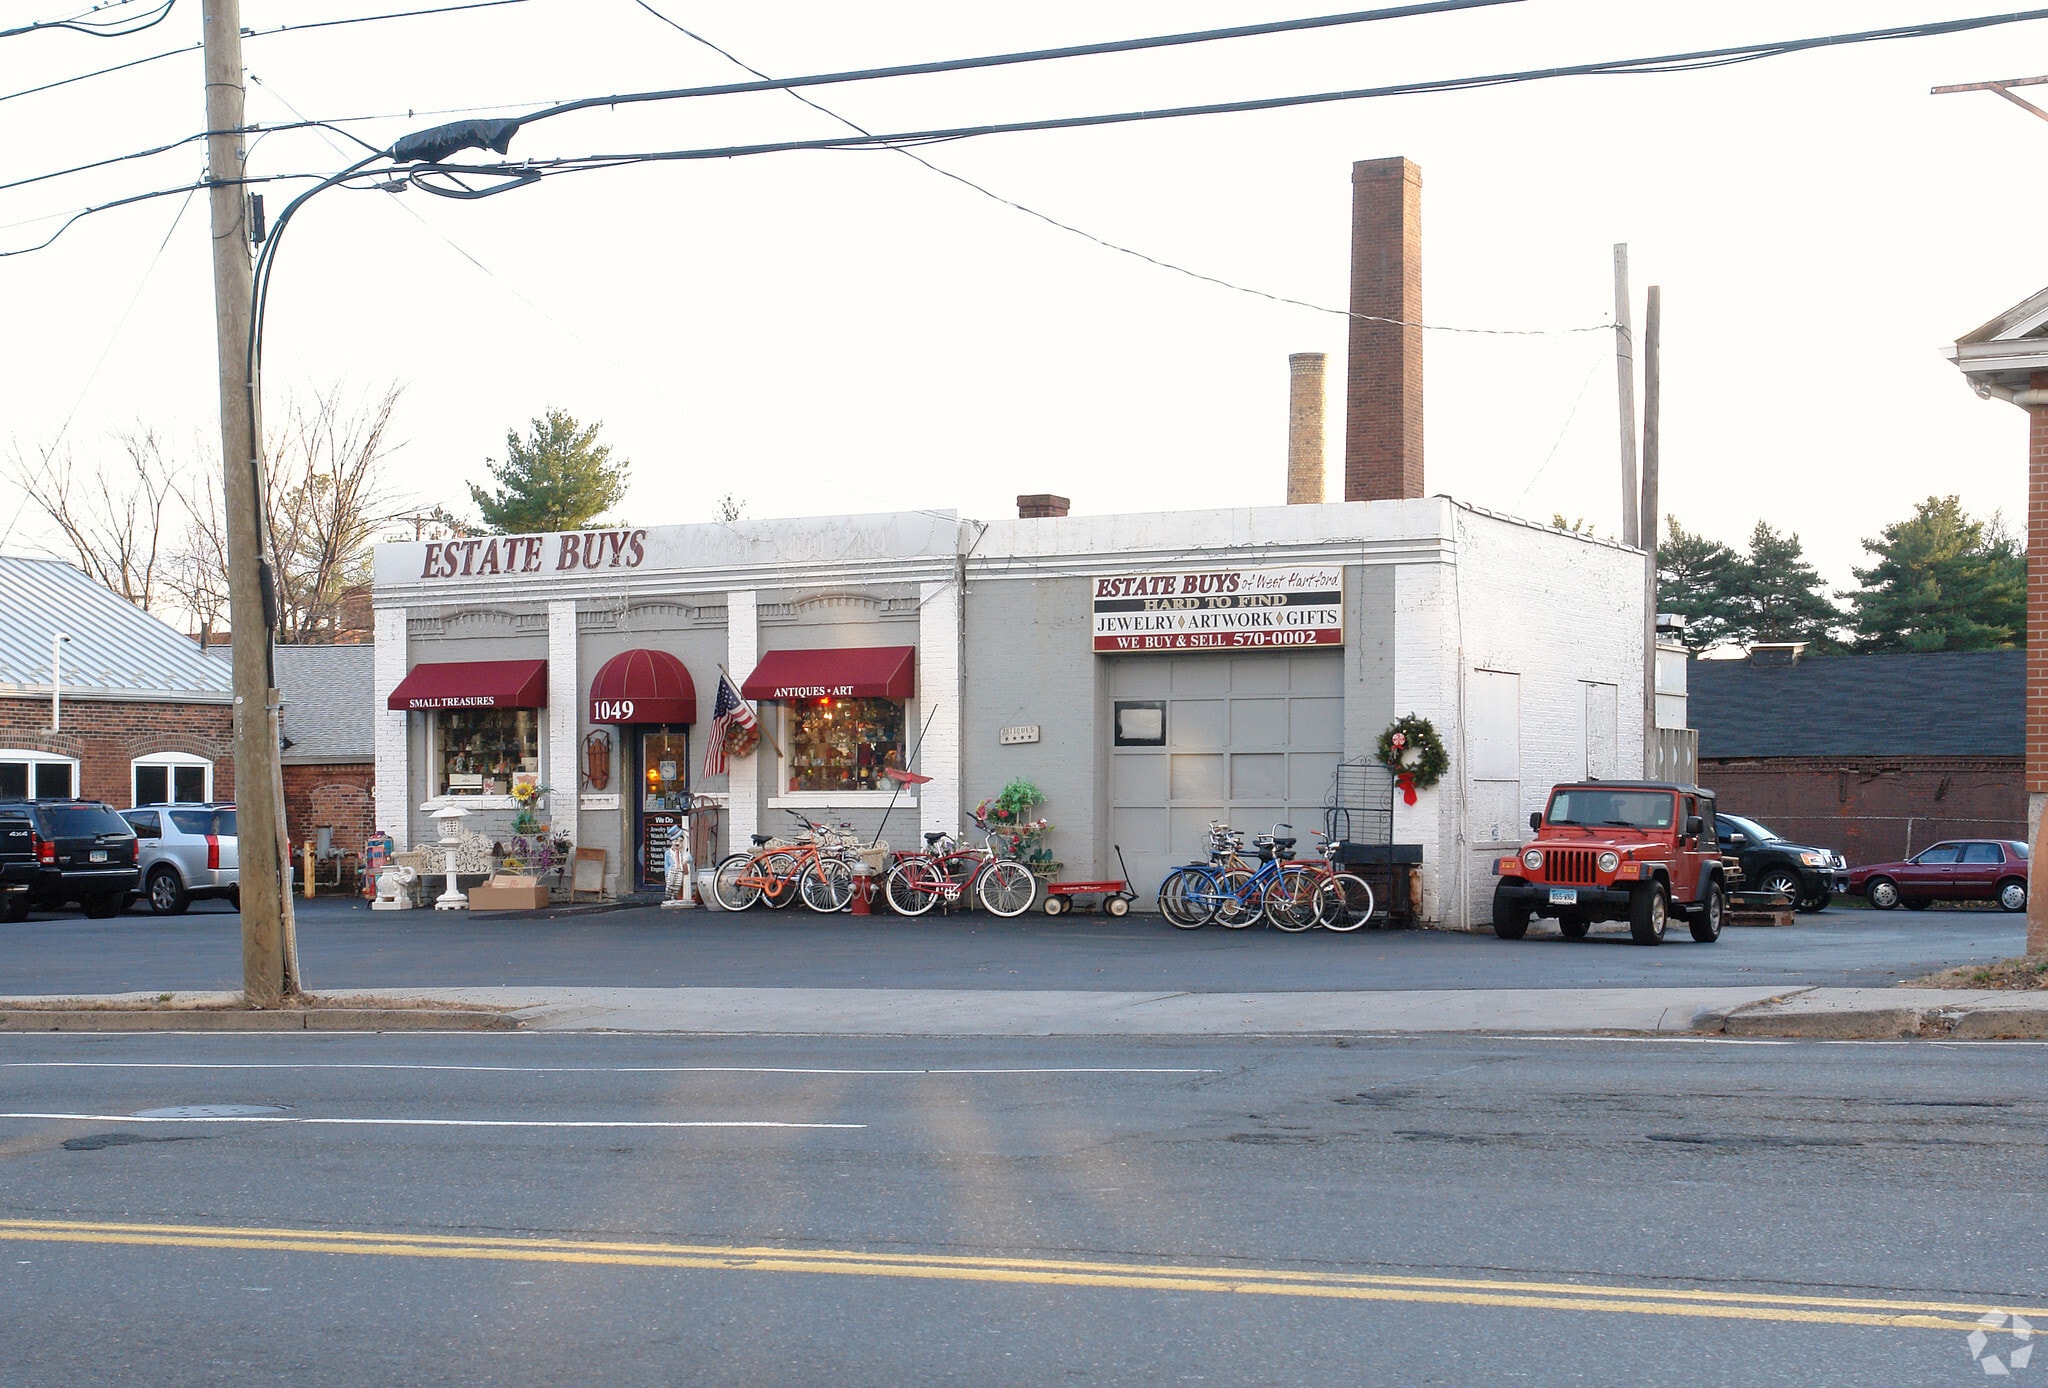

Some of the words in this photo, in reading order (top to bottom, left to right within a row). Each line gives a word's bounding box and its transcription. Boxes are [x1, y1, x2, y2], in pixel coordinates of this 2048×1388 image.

[421, 536, 543, 579] ESTATE
[556, 529, 647, 571] BUYS
[1095, 575, 1177, 598] ESTATE
[1180, 572, 1241, 595] BUYS
[1241, 573, 1255, 590] of
[1256, 574, 1286, 589] West
[1288, 570, 1340, 588] Hartford
[1143, 597, 1200, 612] HARD
[1205, 596, 1232, 609] TO
[1238, 594, 1288, 608] FIND
[1097, 615, 1176, 632] JEWELRY
[1188, 611, 1273, 629] ARTWORK
[1286, 609, 1338, 626] GIFTS
[1117, 636, 1140, 649] WE
[1145, 635, 1173, 648] BUY
[1175, 634, 1187, 647] &
[1190, 633, 1227, 647] SELL
[1233, 630, 1317, 646] 570-0002
[774, 685, 826, 698] ANTIQUES
[832, 685, 854, 696] ART
[409, 698, 441, 708] SMALL
[441, 696, 495, 707] TREASURES
[594, 700, 635, 720] 1049
[665, 816, 674, 824] Do
